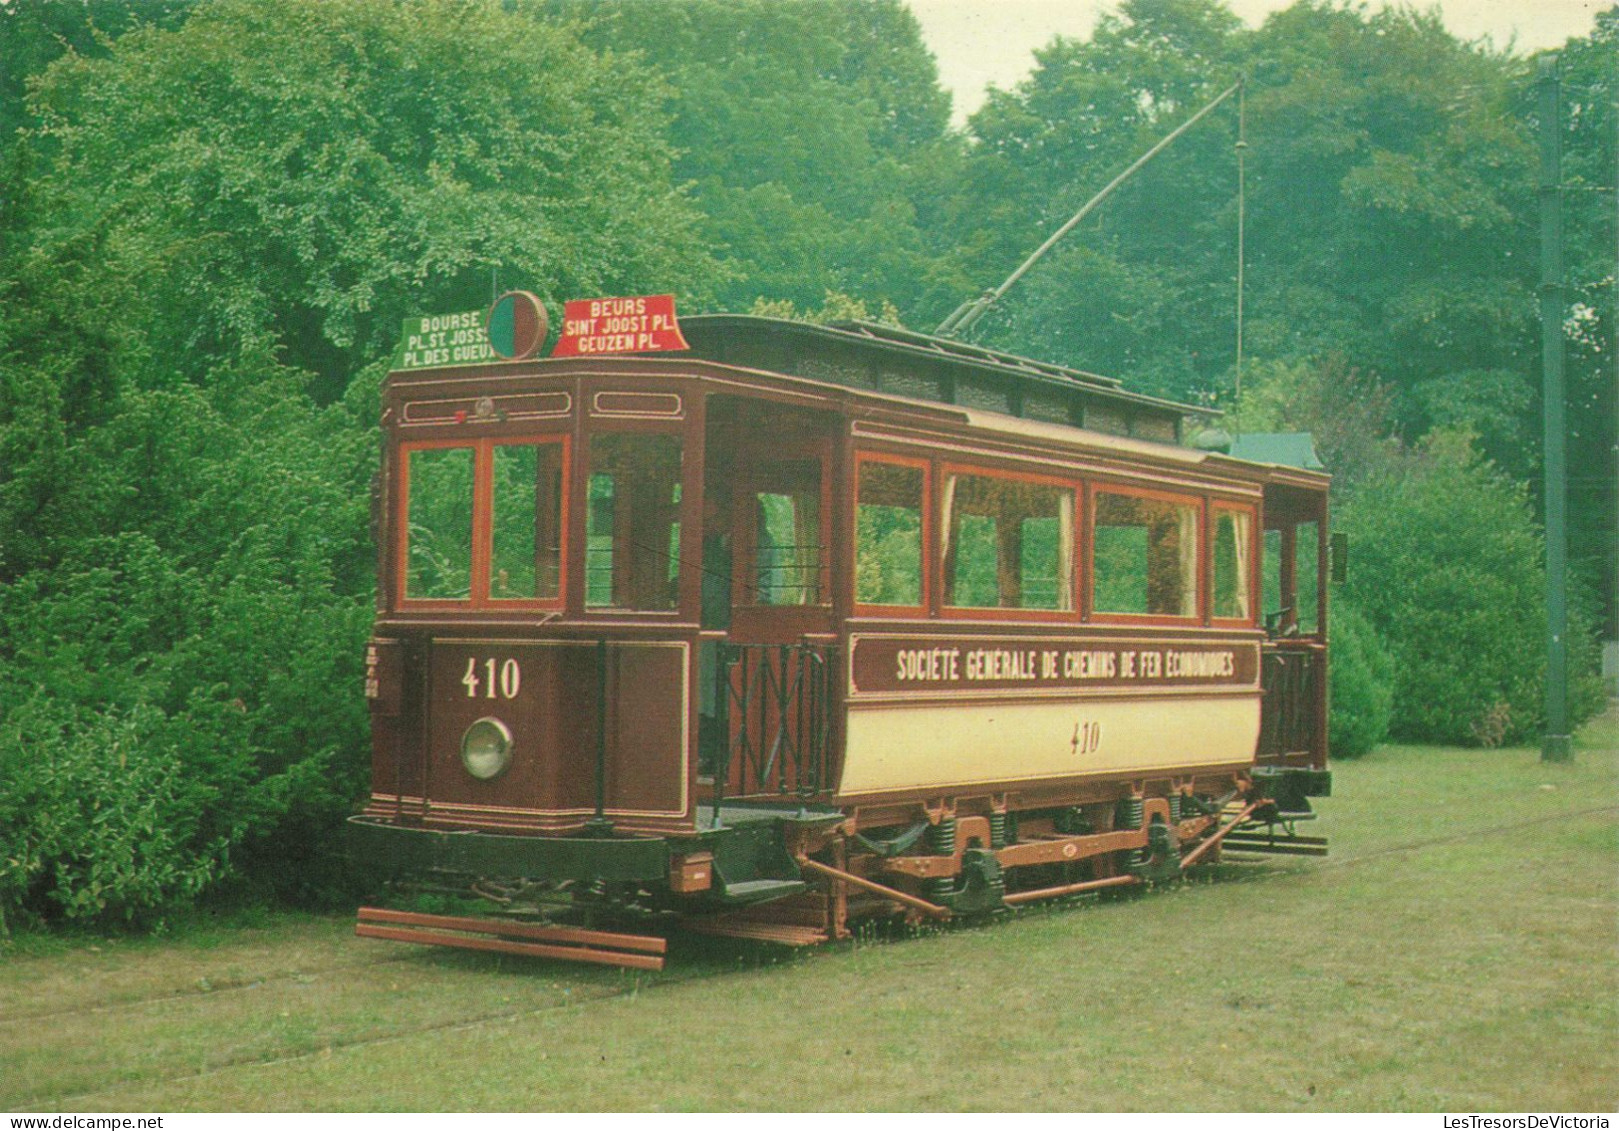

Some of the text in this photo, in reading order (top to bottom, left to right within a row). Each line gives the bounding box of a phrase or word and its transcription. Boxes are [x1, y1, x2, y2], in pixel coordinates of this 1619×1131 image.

[590, 298, 646, 317] BEURS
[420, 311, 481, 334] BOURSE
[566, 319, 597, 336] SINT
[602, 315, 649, 334] JOOST
[578, 334, 634, 353] GEUZEN
[424, 348, 449, 365] DES
[897, 647, 1234, 680] SOCIÉTÉ GÉNÉRALE DE CHEMINS DE FER ÉCONOMIQUES
[461, 657, 521, 699] 410
[1070, 721, 1100, 755] 410
